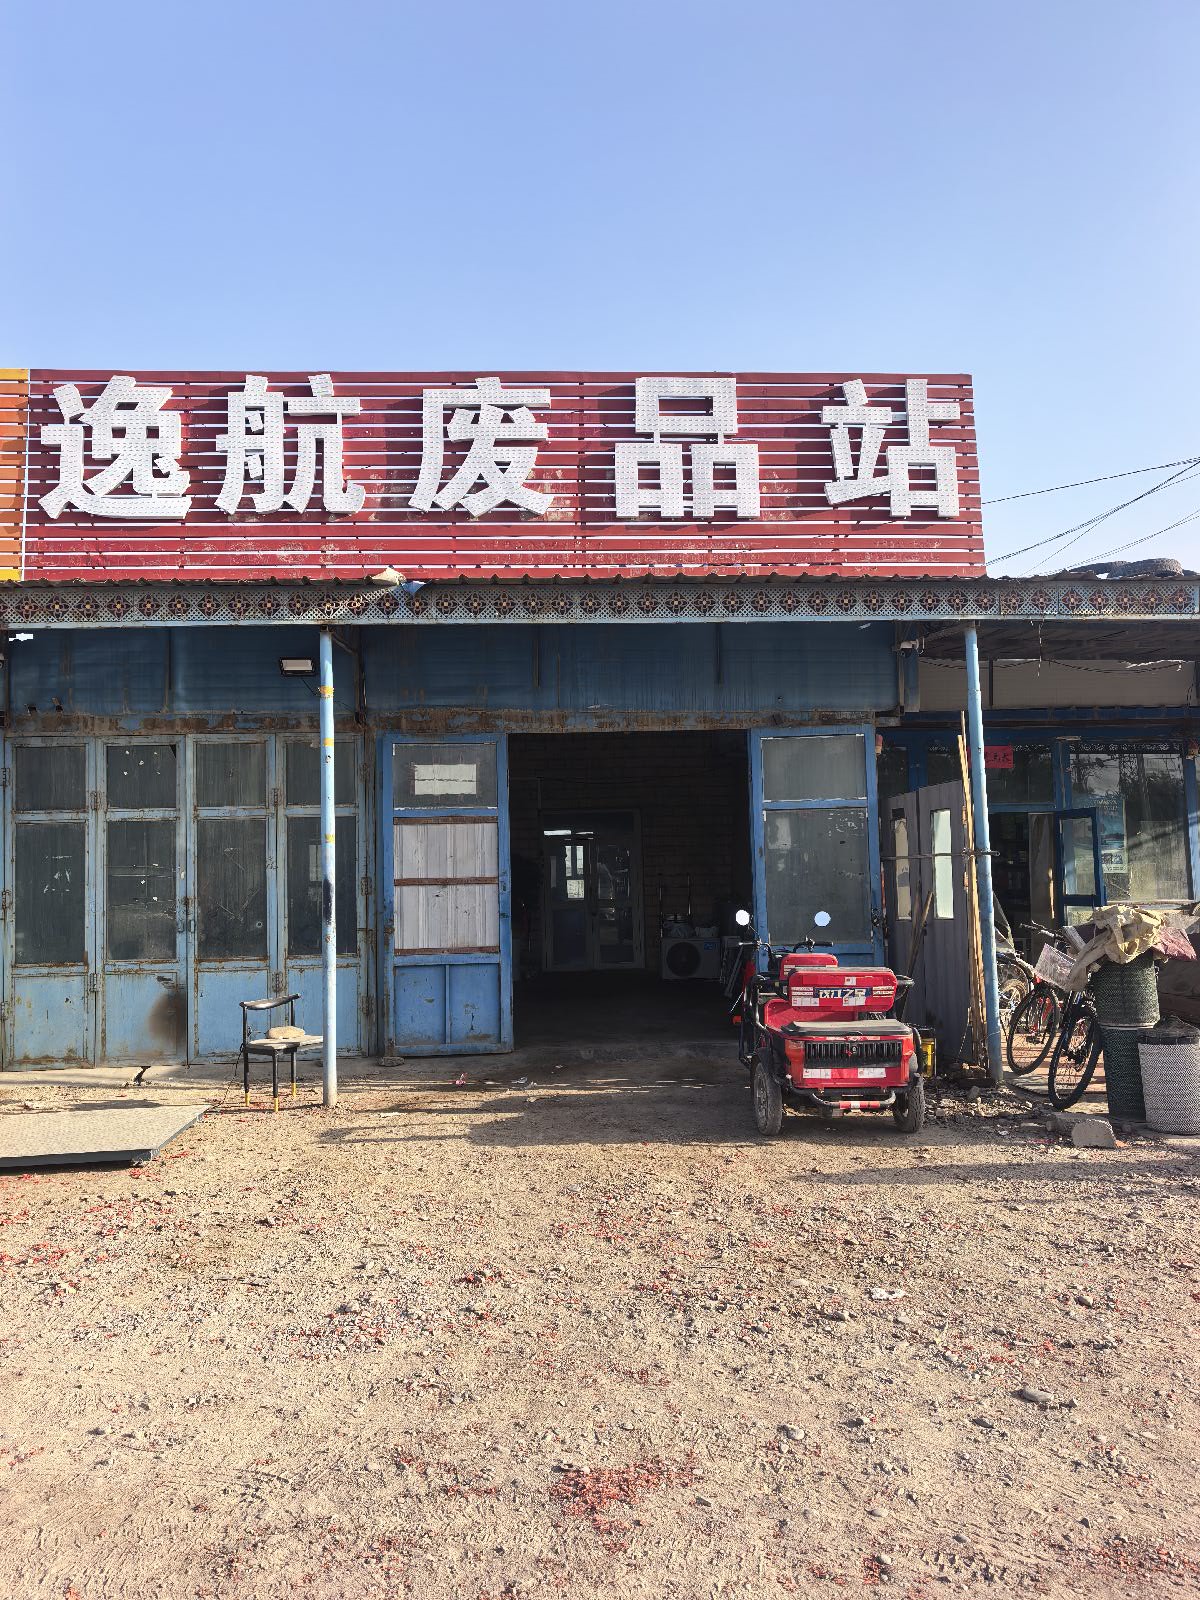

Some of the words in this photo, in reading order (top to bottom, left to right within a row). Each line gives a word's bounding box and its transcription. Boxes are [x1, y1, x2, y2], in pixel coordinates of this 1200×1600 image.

[38, 374, 960, 519] 逸航废品站
